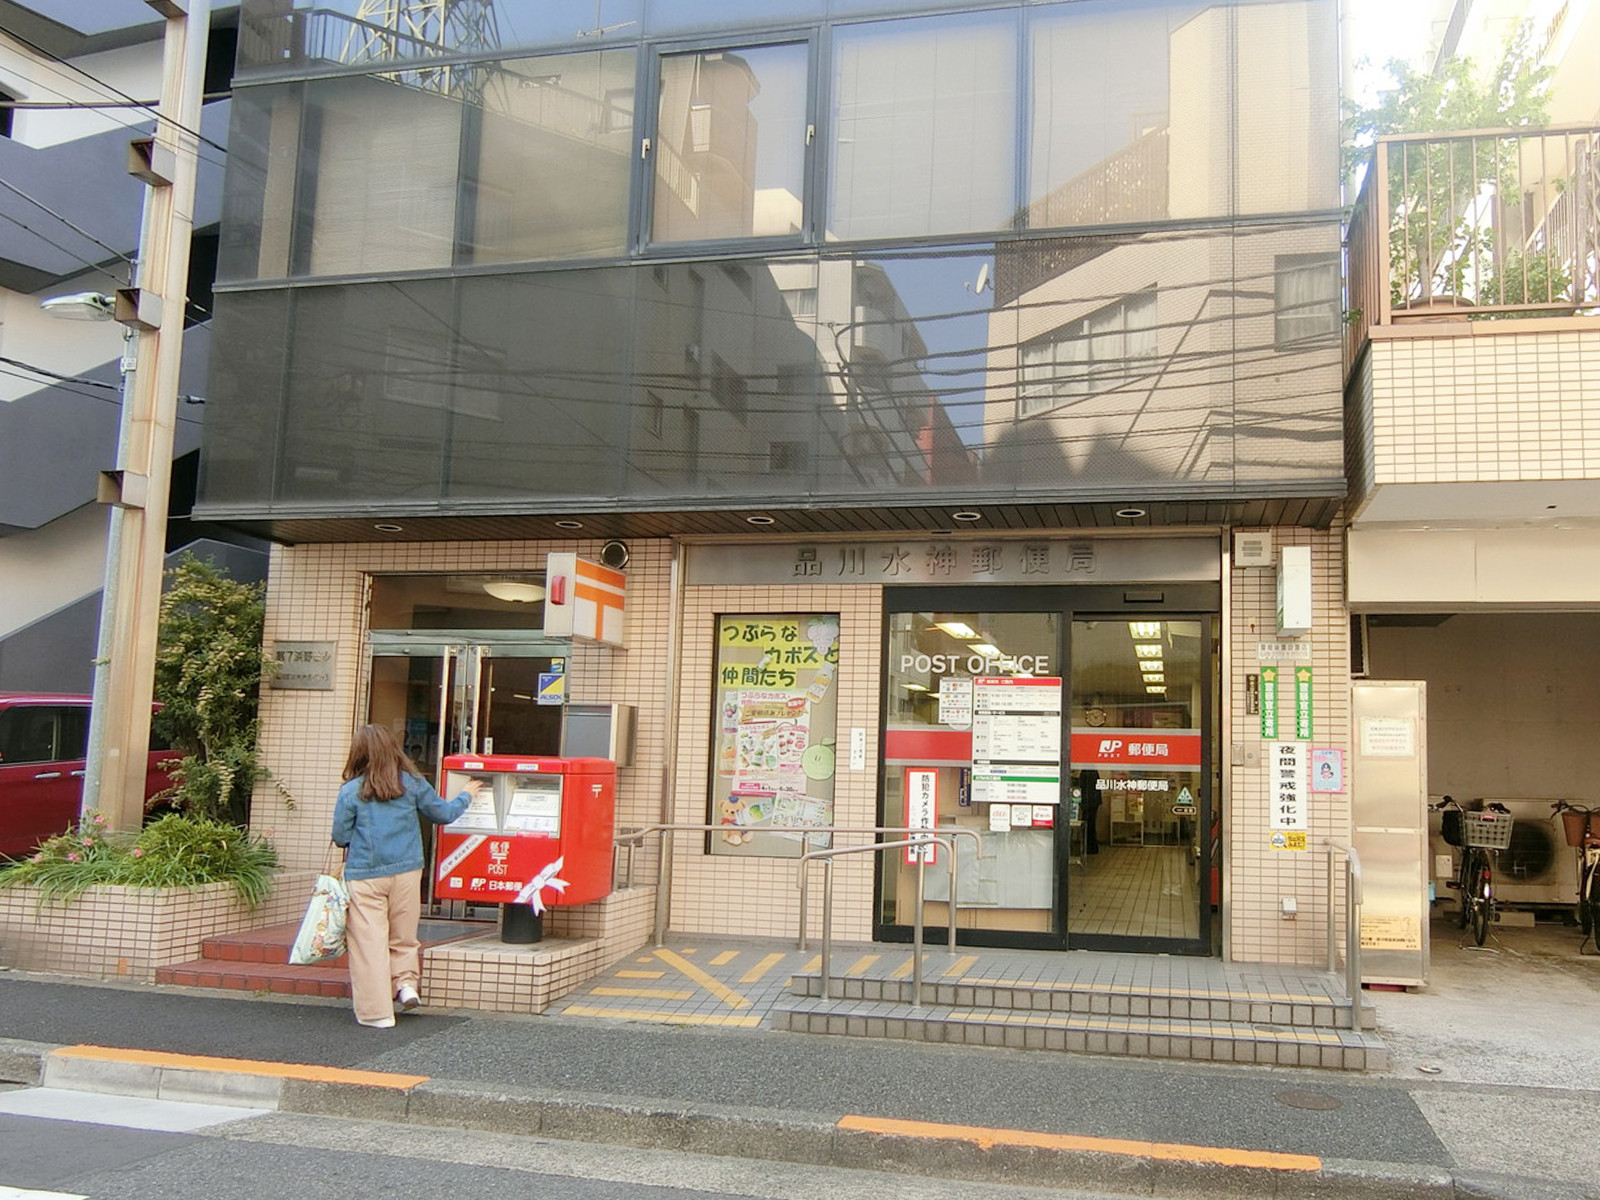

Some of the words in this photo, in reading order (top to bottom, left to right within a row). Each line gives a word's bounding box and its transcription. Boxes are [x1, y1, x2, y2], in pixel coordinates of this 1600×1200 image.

[792, 543, 1098, 577] 品川水神郵便局
[723, 623, 798, 642] つぶらな
[764, 645, 839, 664] カボスと
[900, 654, 960, 673] POST
[967, 655, 1050, 675] OFFICE
[721, 666, 796, 687] 仲間たち
[1127, 743, 1169, 757] 郵便局
[1095, 779, 1169, 792] 品川水神郵便局
[1279, 745, 1297, 826] 夜間警戒強化中
[489, 841, 510, 854] 郵便
[488, 864, 509, 876] POST
[489, 881, 523, 891] 日本郵便
